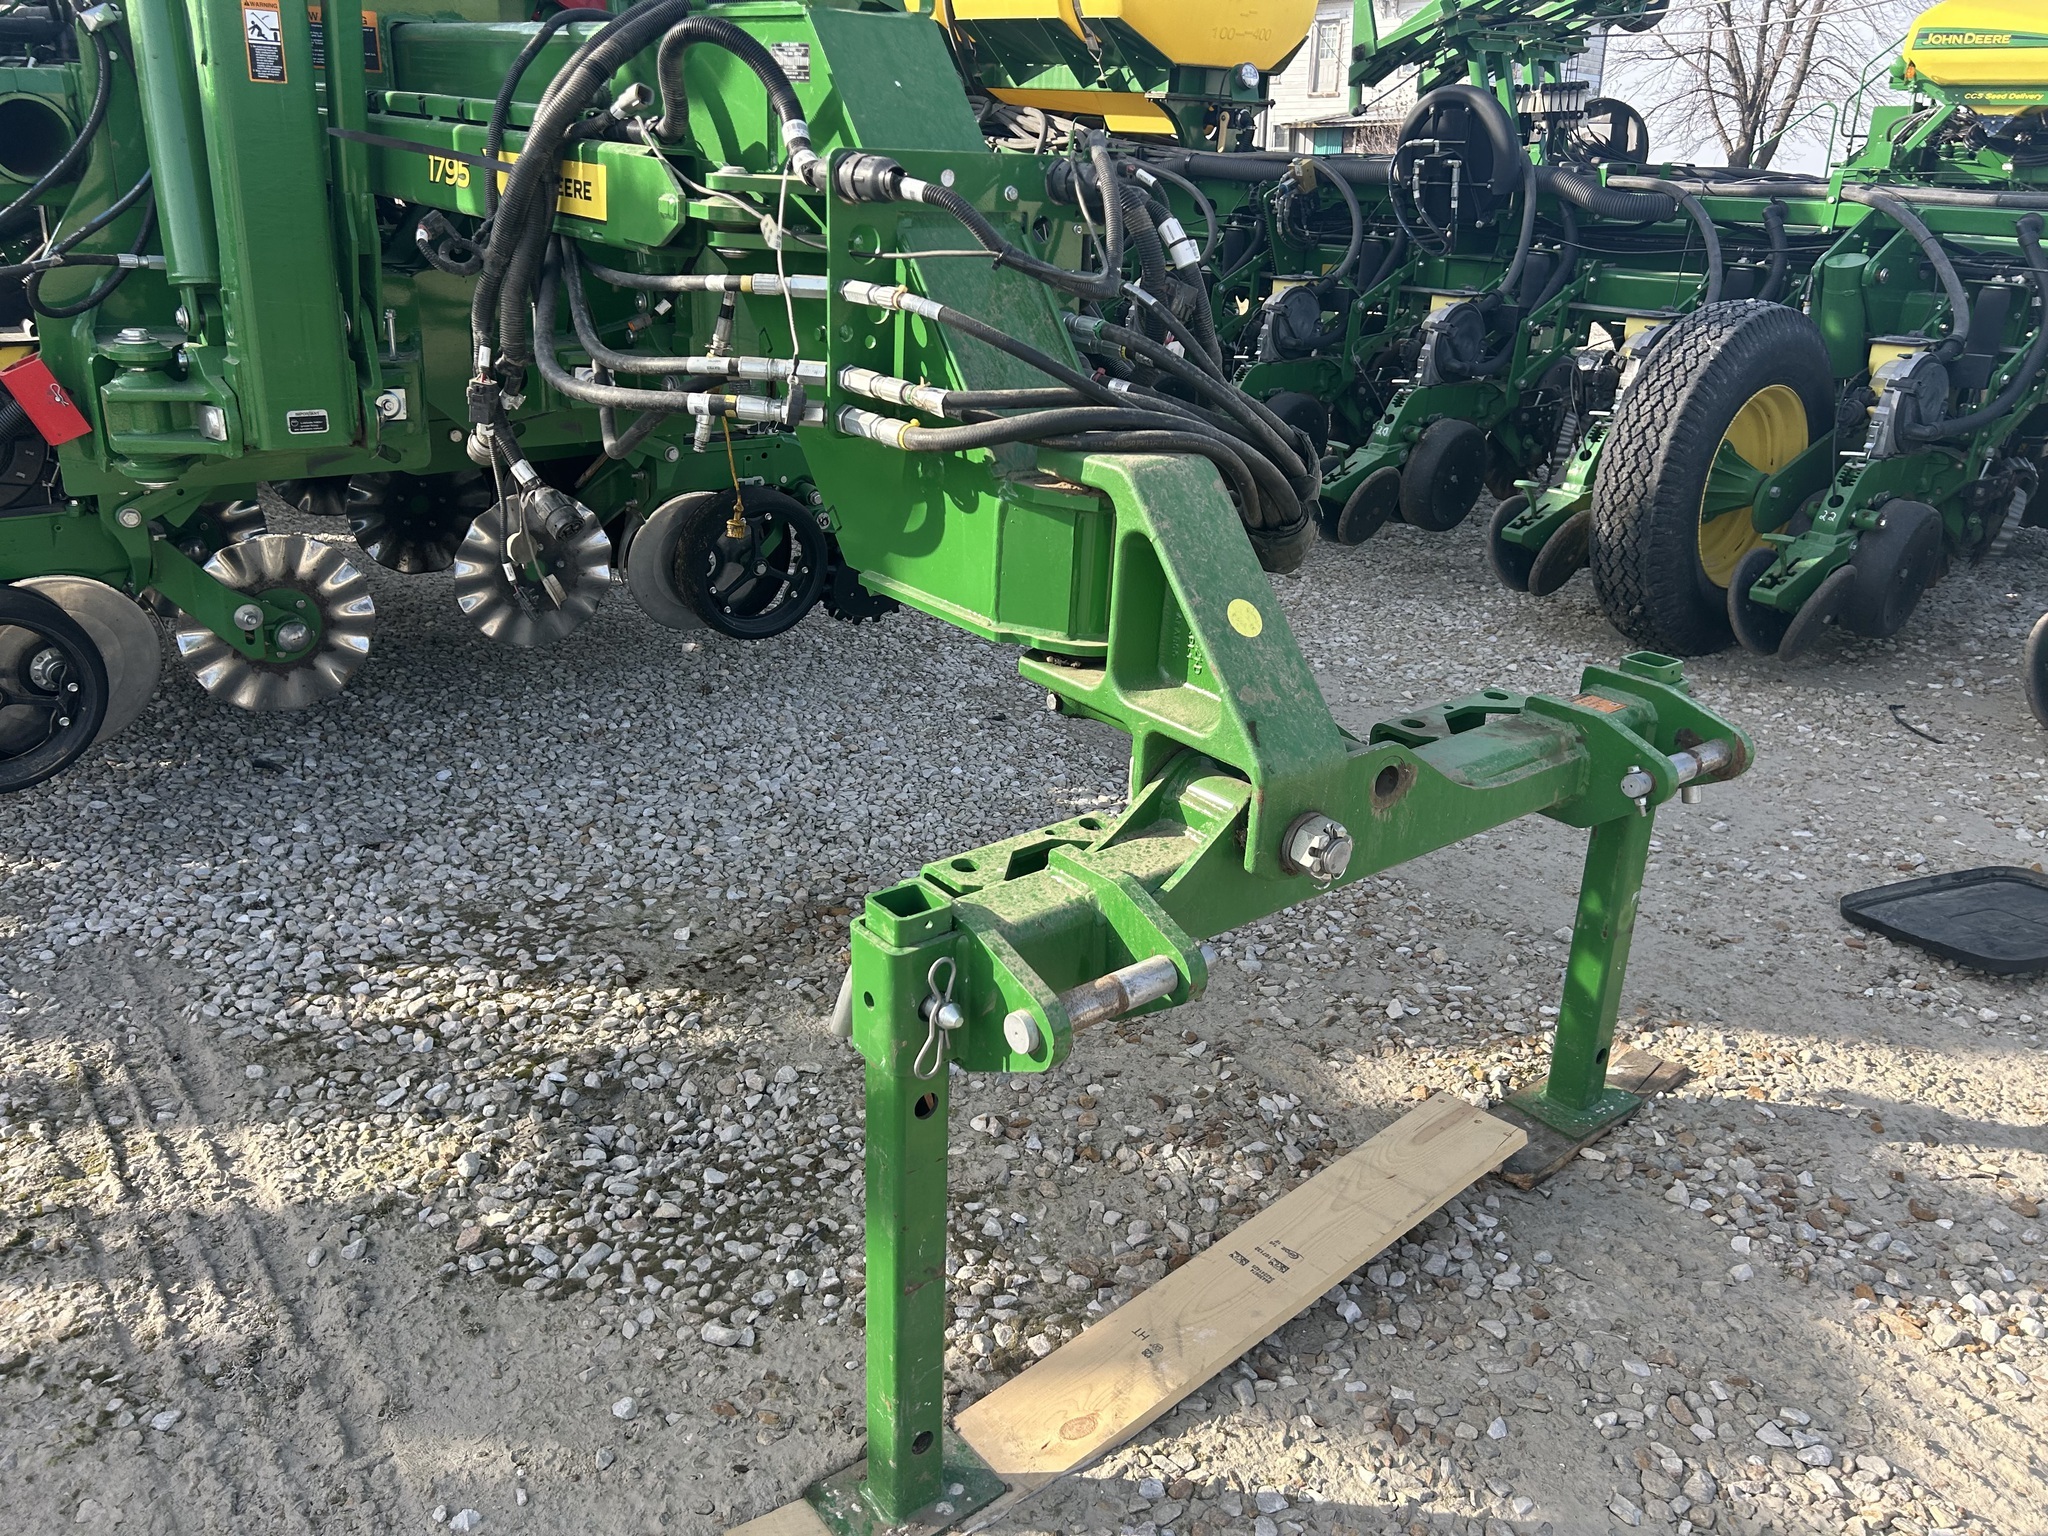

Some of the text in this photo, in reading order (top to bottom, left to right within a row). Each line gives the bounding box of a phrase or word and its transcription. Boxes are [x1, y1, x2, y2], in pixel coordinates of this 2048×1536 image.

[250, 1, 278, 9] WARNING
[1922, 32, 2012, 45] JOHN DEERE
[2008, 93, 2044, 101] Delivery
[428, 154, 471, 188] 1795
[558, 178, 592, 201] EERE
[1818, 509, 1837, 522] 22
[1131, 1327, 1150, 1341] HT
